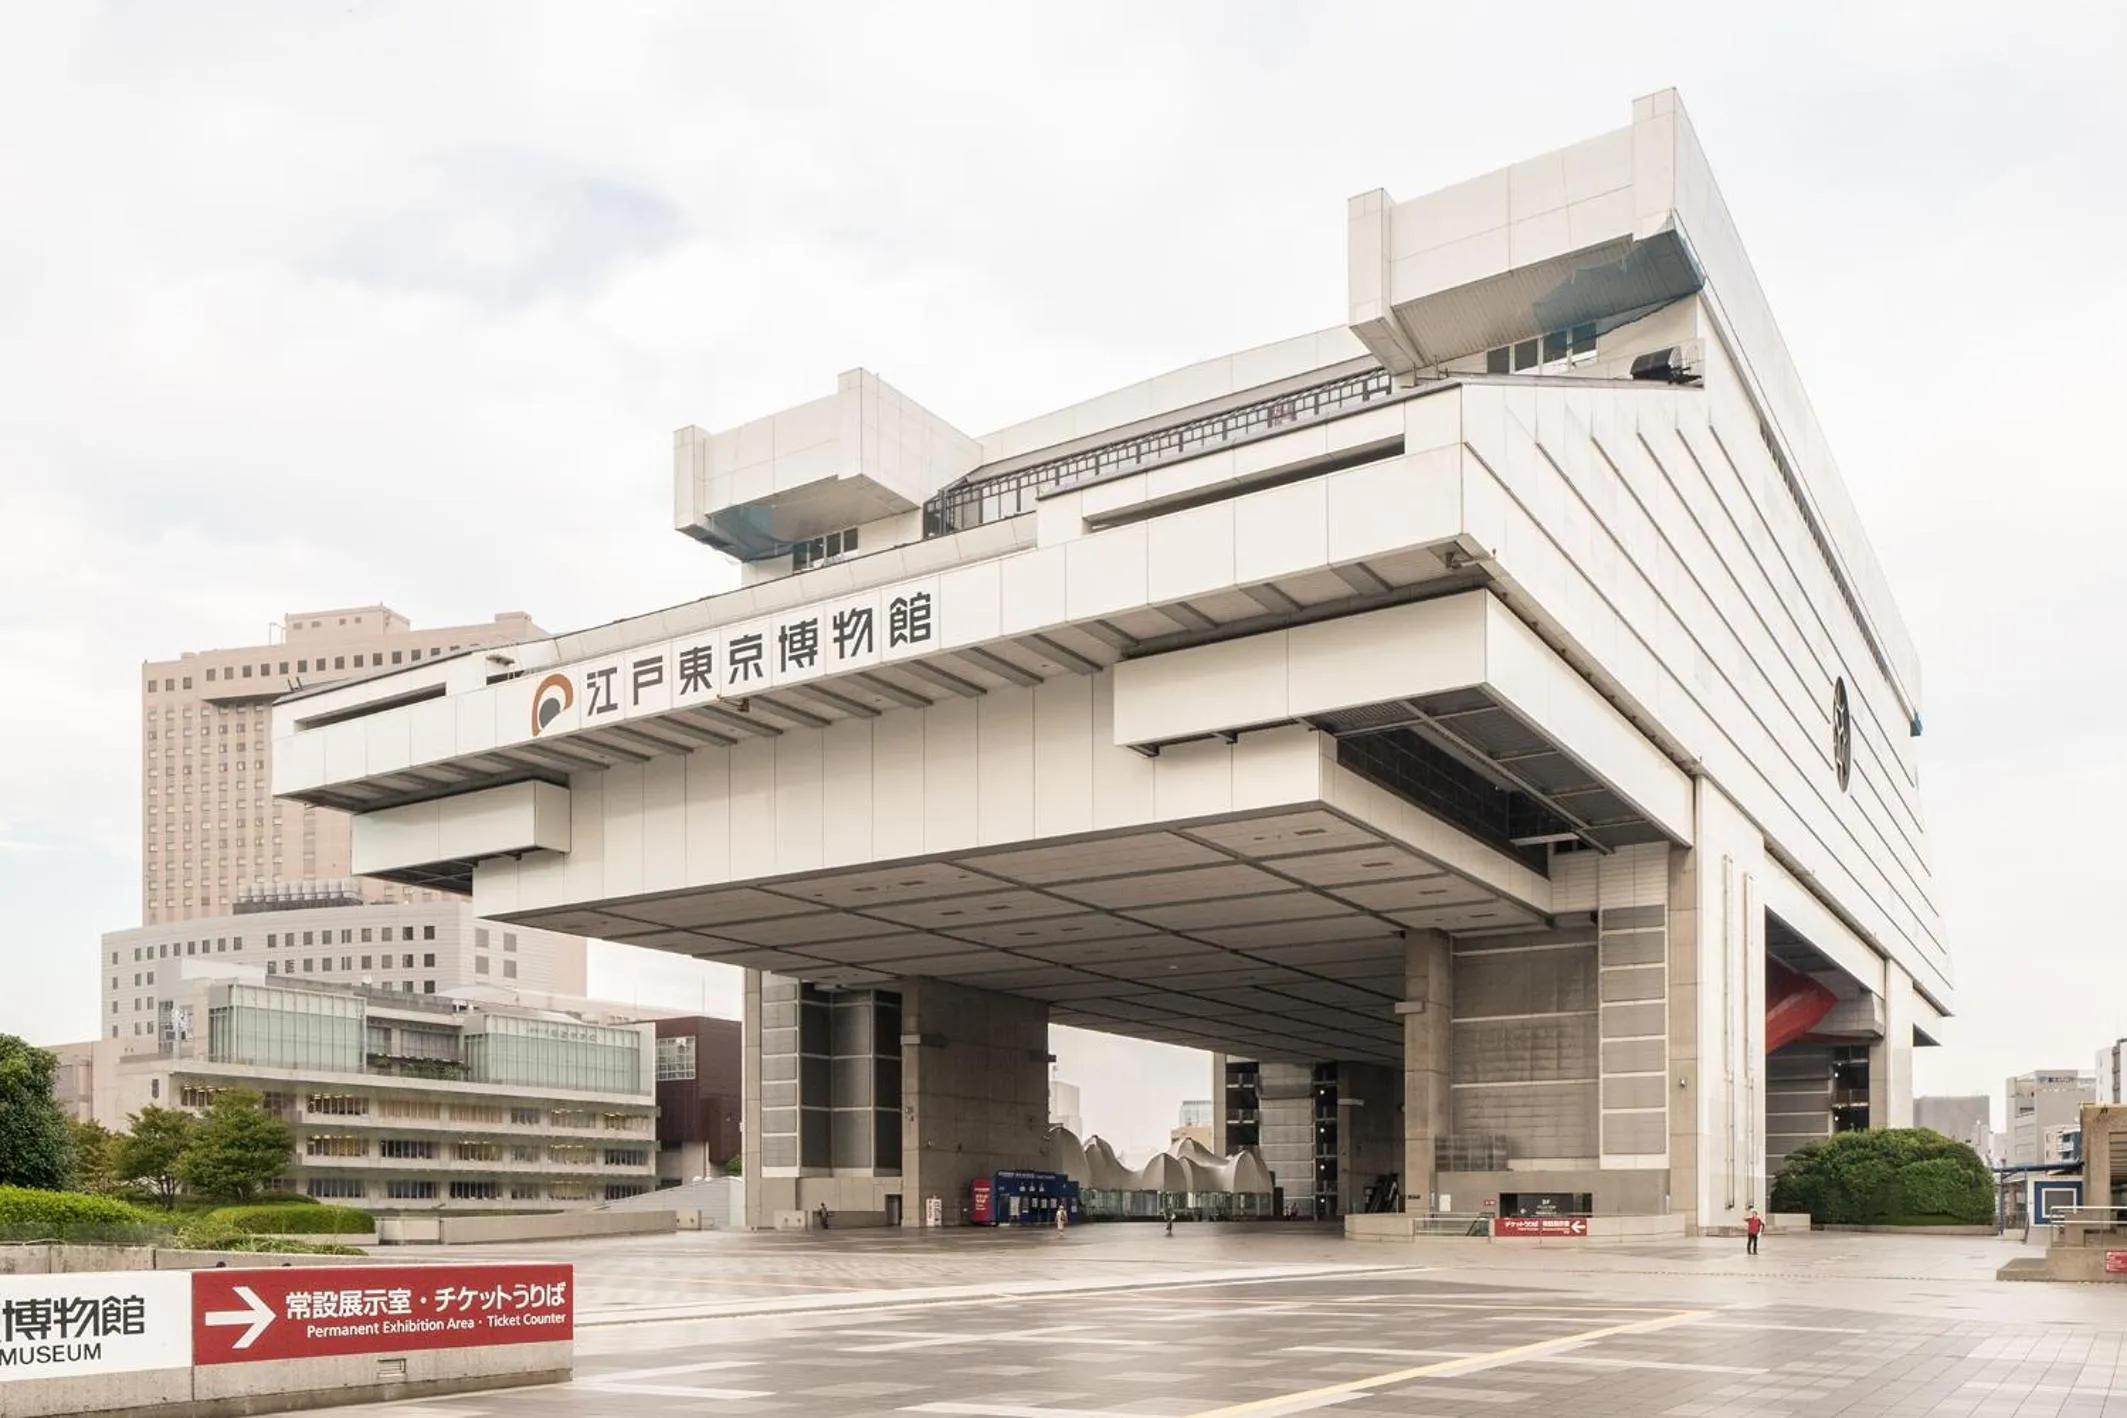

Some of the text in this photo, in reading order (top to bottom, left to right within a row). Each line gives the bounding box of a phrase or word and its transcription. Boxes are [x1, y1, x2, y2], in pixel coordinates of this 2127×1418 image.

[586, 591, 931, 716] 江戸東京博物館
[0, 1295, 145, 1342] 博物館
[285, 1281, 567, 1320] 常設展示室・チケットうりば
[307, 1311, 567, 1338] Permanent Exhibition Area Ticket Counter
[0, 1343, 101, 1366] MUSEUM
